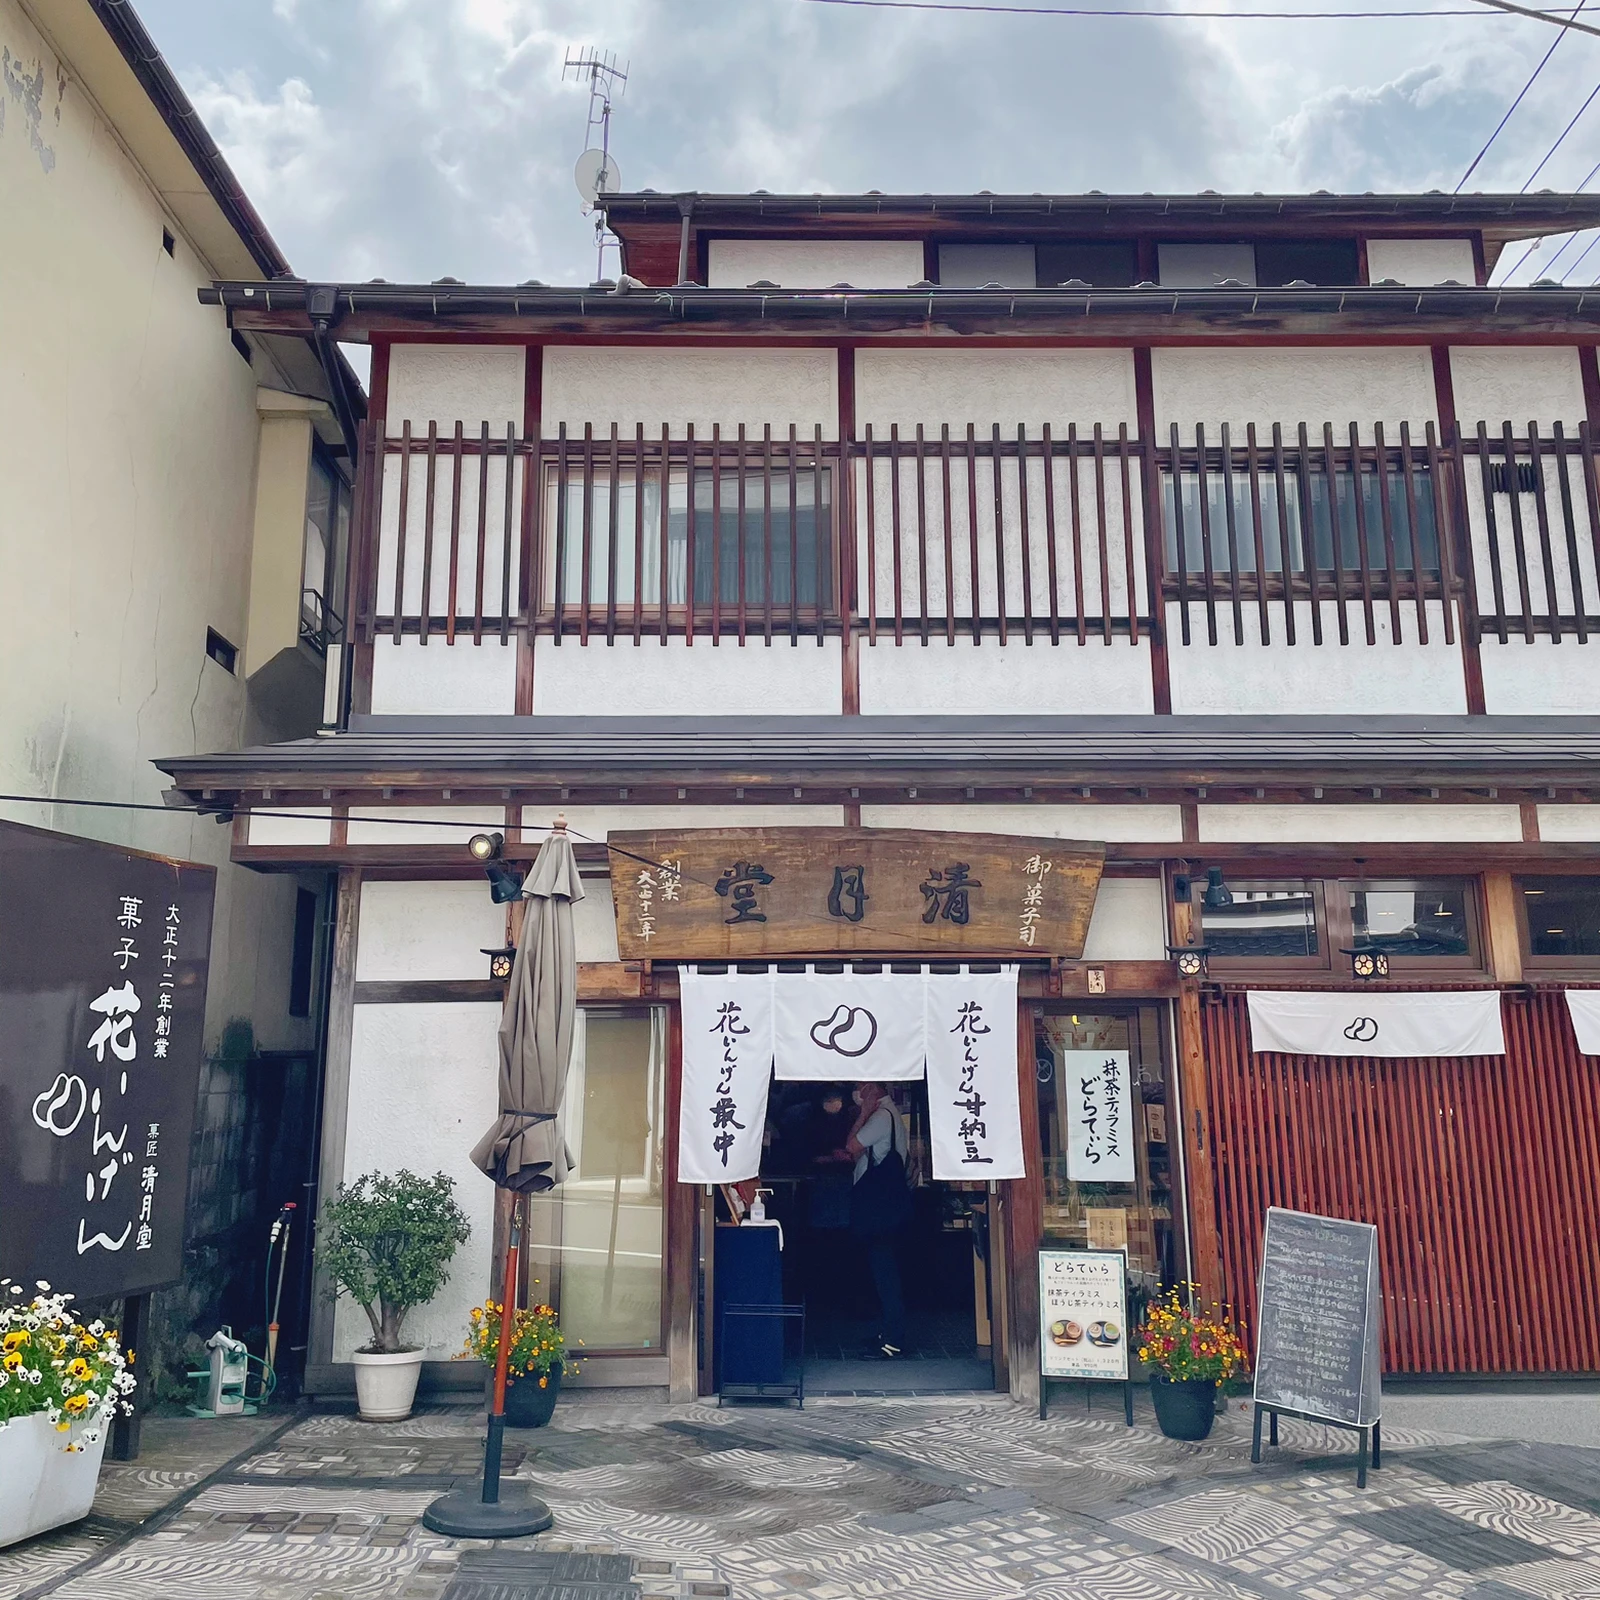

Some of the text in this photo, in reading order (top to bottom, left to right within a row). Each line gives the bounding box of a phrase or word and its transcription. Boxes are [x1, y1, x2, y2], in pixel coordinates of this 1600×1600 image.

[636, 870, 657, 942] 大正十二年
[656, 859, 682, 901] 創業
[714, 859, 982, 925] 清月堂
[1018, 855, 1052, 946] 御菓子司
[113, 895, 143, 970] 菓子
[154, 903, 181, 1059] 大正十二年創業
[709, 1001, 750, 1167] 花いんげん最中
[949, 1001, 993, 1164] 花いんげん甘納豆
[1102, 1058, 1121, 1158] 抹茶ティラミス
[136, 1123, 160, 1250] 菓匠 清月堂
[1047, 1288, 1101, 1299] 抹茶ティラミス
[1051, 1299, 1120, 1309] ほうじ茶ティラミス
